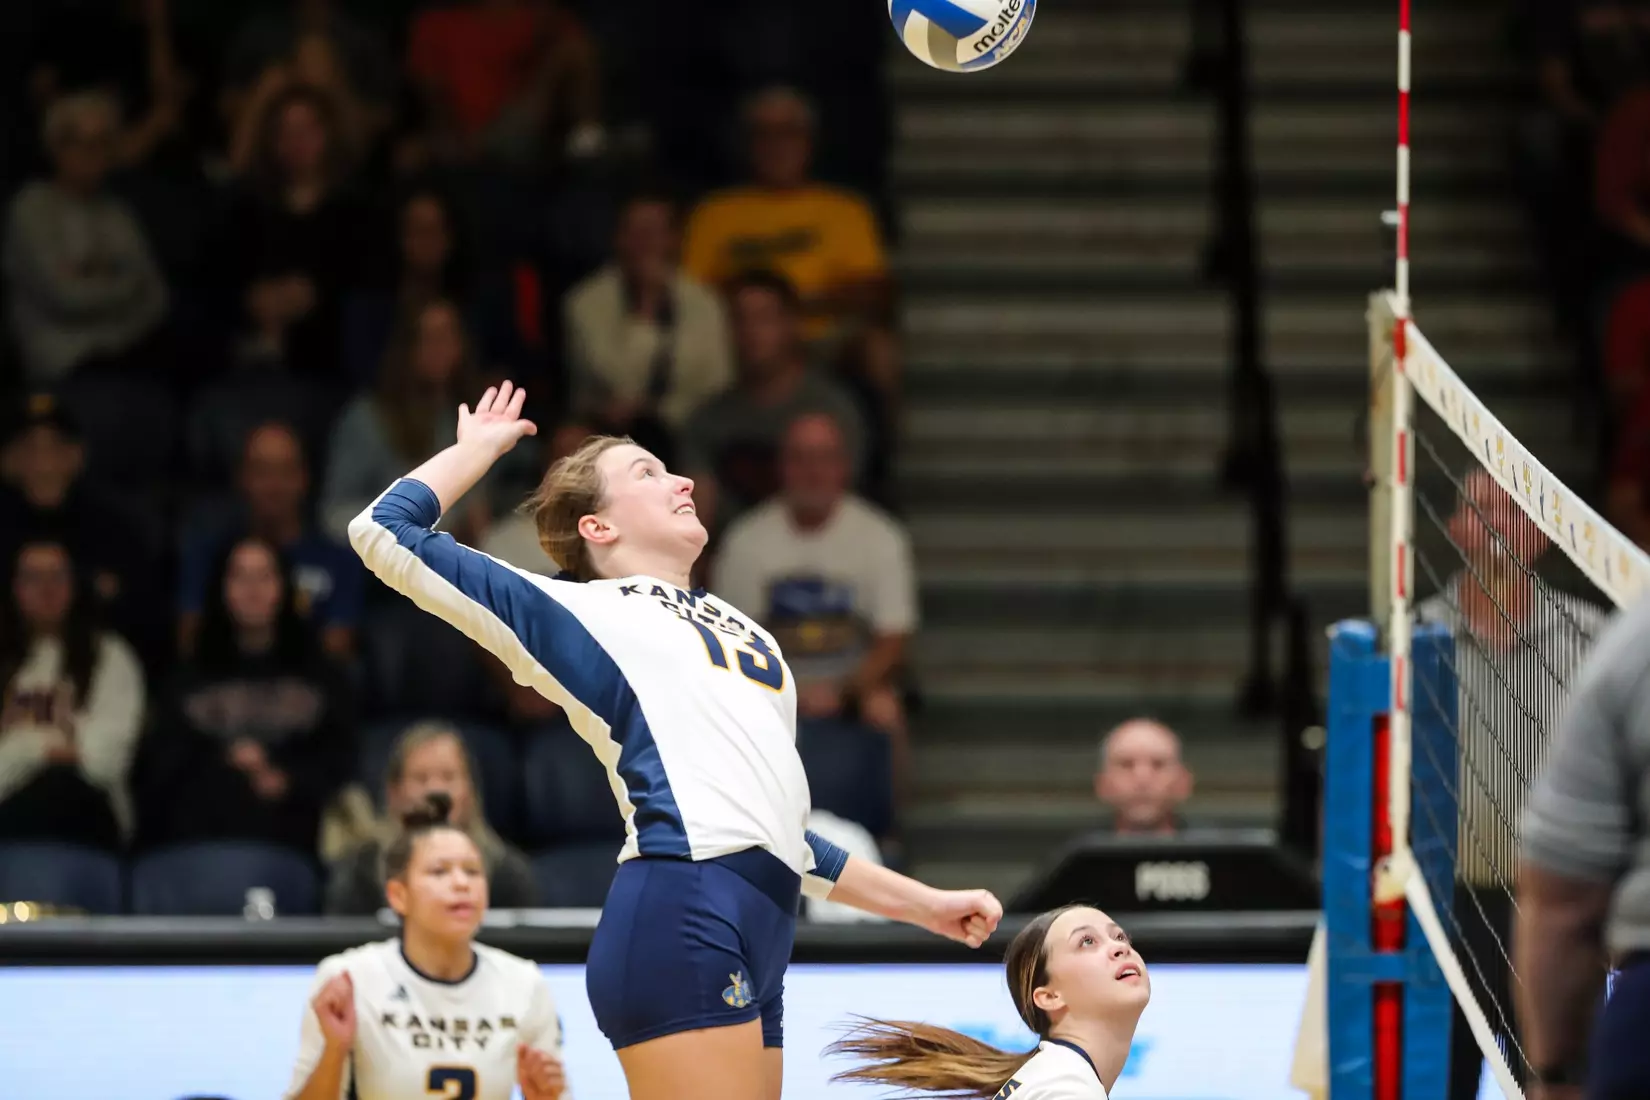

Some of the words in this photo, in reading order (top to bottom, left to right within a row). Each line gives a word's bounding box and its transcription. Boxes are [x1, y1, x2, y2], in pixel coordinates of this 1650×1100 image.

[678, 615, 785, 693] 13
[382, 1013, 516, 1031] KANSAS
[413, 1034, 488, 1050] CITY
